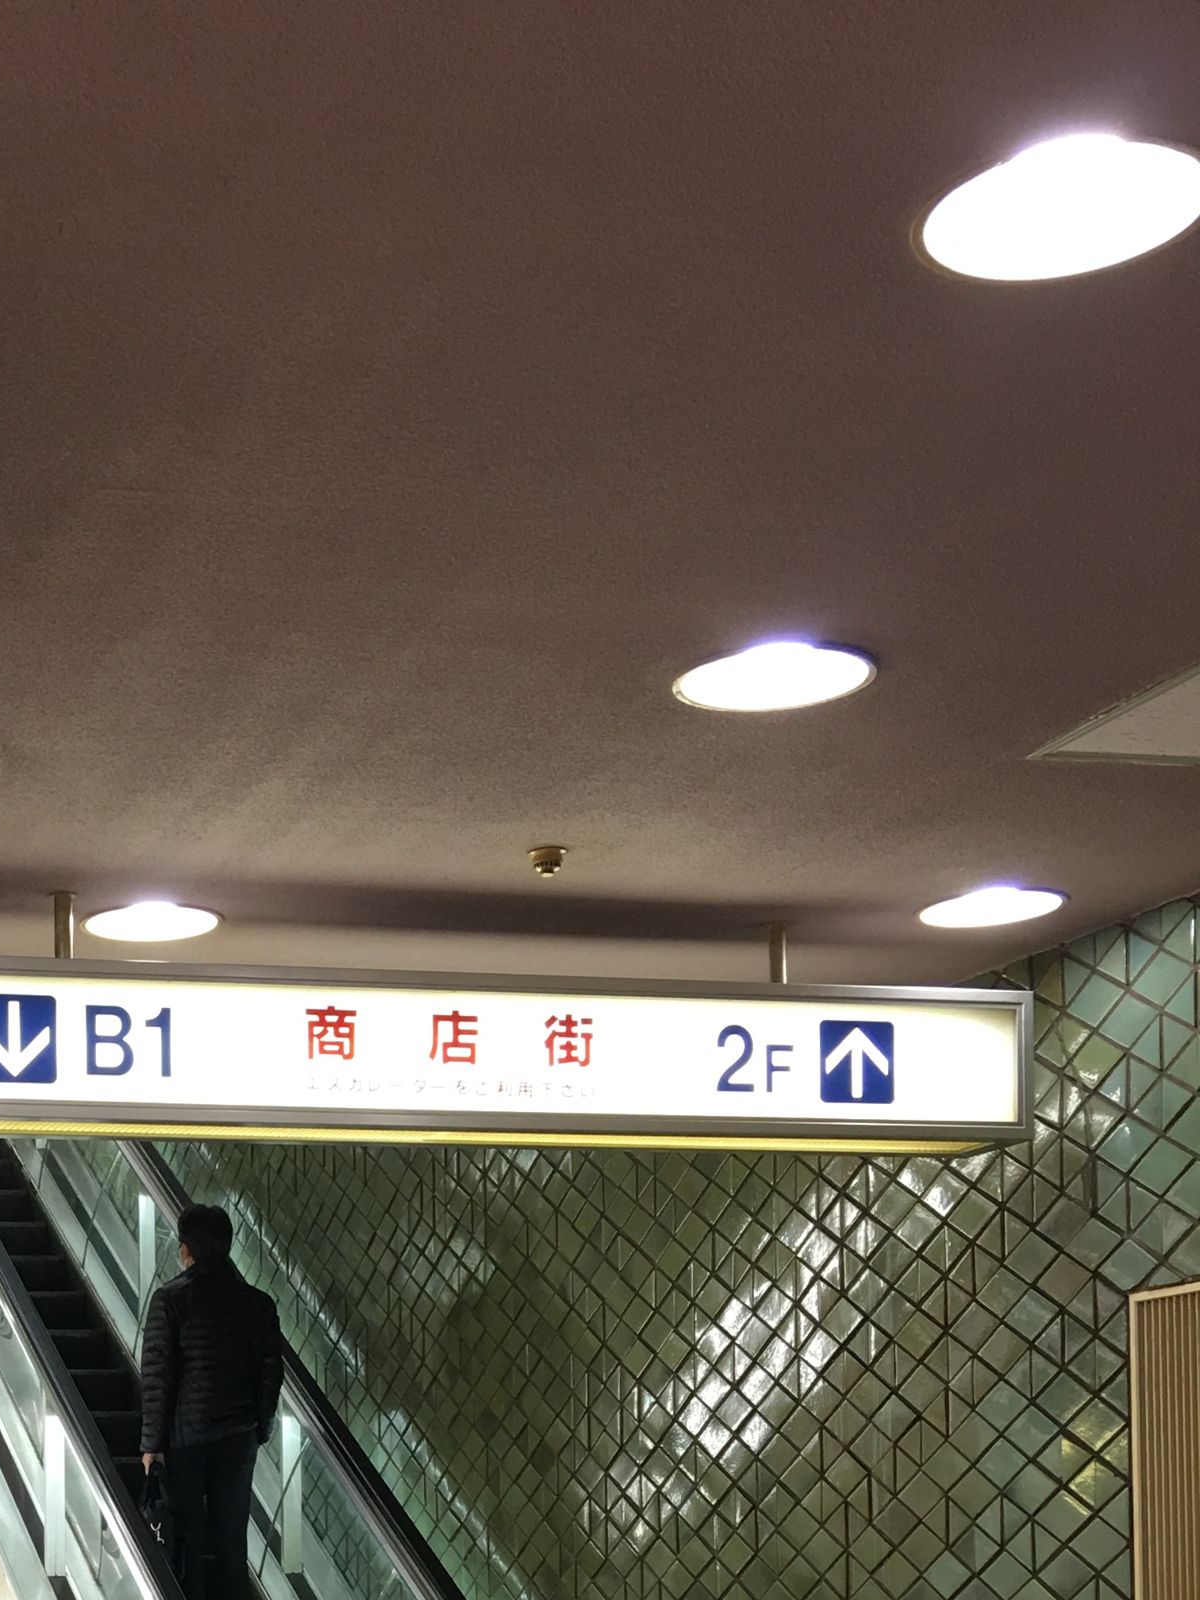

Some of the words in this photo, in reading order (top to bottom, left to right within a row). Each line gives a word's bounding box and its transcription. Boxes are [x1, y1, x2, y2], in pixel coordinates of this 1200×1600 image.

[84, 1003, 173, 1078] B1
[305, 1005, 595, 1069] 商店街
[715, 1023, 795, 1093] 2F
